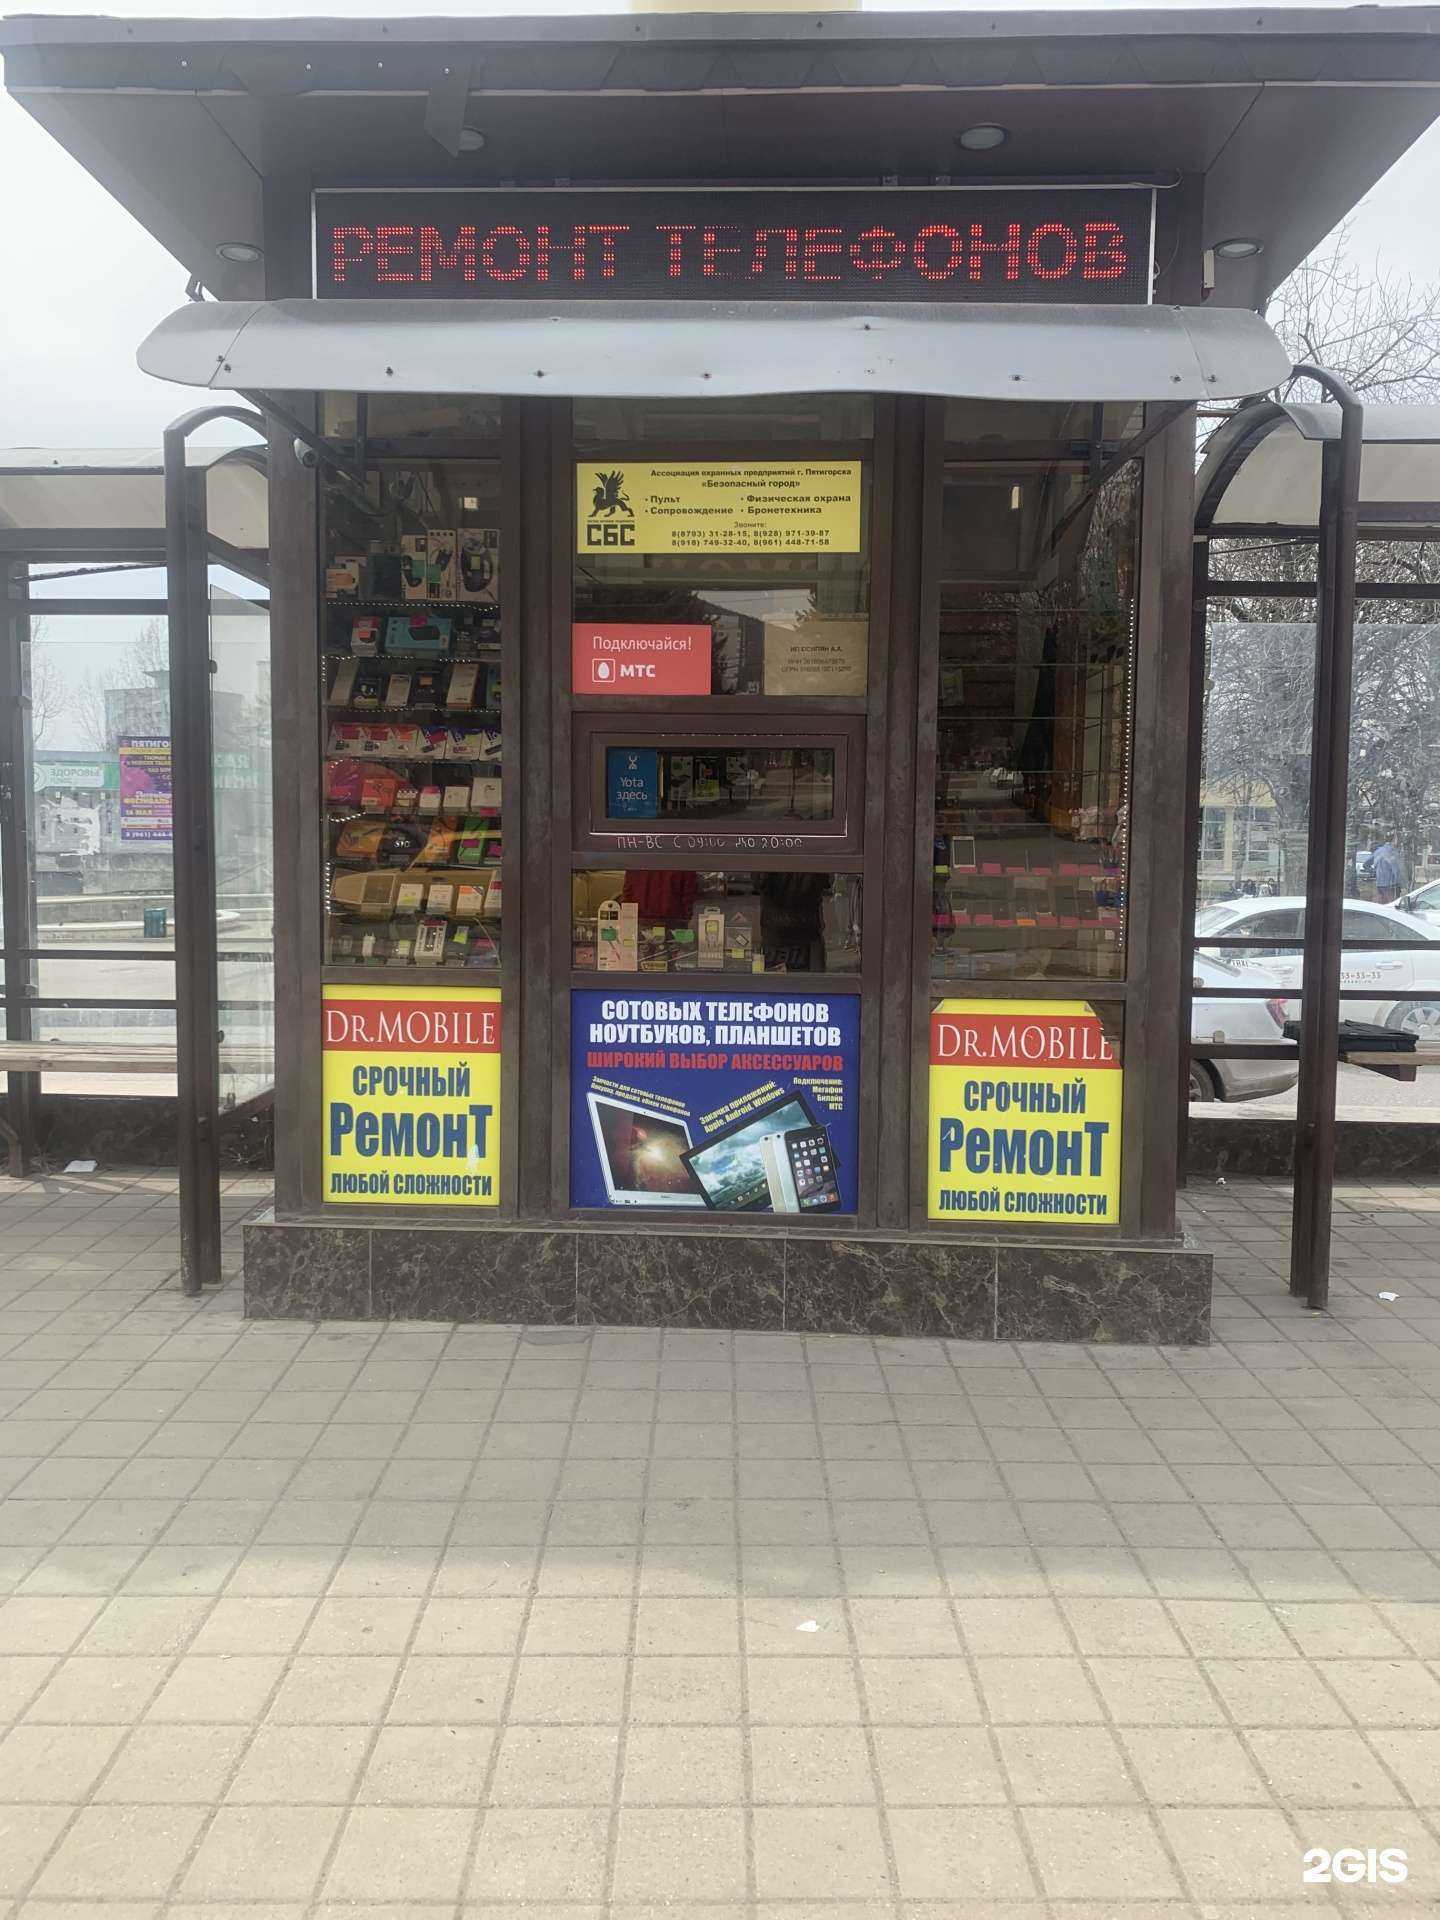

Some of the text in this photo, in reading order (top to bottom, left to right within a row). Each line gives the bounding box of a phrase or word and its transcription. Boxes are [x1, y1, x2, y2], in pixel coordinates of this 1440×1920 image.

[332, 221, 1128, 283] РЕМОНТ ТЕЛЕФОНОВ
[650, 495, 681, 505] Пульт
[746, 494, 851, 503] Физическая охрана
[650, 506, 734, 516] Сопровождение
[747, 505, 822, 515] Бронетехника
[587, 524, 635, 546] СБС
[592, 635, 692, 653] Подключайся!
[620, 664, 656, 677] МТС
[131, 740, 172, 748] ПЯТИГО
[620, 776, 644, 788] Yota
[616, 791, 648, 801] здесь
[616, 836, 663, 849] ПН-ВС
[601, 1000, 830, 1023] СОТОВЫХ ТЕЛЕФОНОВ
[589, 1023, 842, 1047] НОУТБУКОВ, ПЛАНШЕТОВ
[586, 1050, 843, 1071] ШИРОКИЙ ВЫБОР АКСЕССУАРОВ
[352, 1061, 471, 1097] СРОЧНЫЙ
[753, 1087, 785, 1108] Windows
[963, 1077, 1087, 1114] СРОЧНЫЙ
[330, 1170, 492, 1196] ЛЮБОЙ СЛОЖНОСТИ
[939, 1187, 1107, 1216] ЛЮБОЙ СЛОЖНОСТИ
